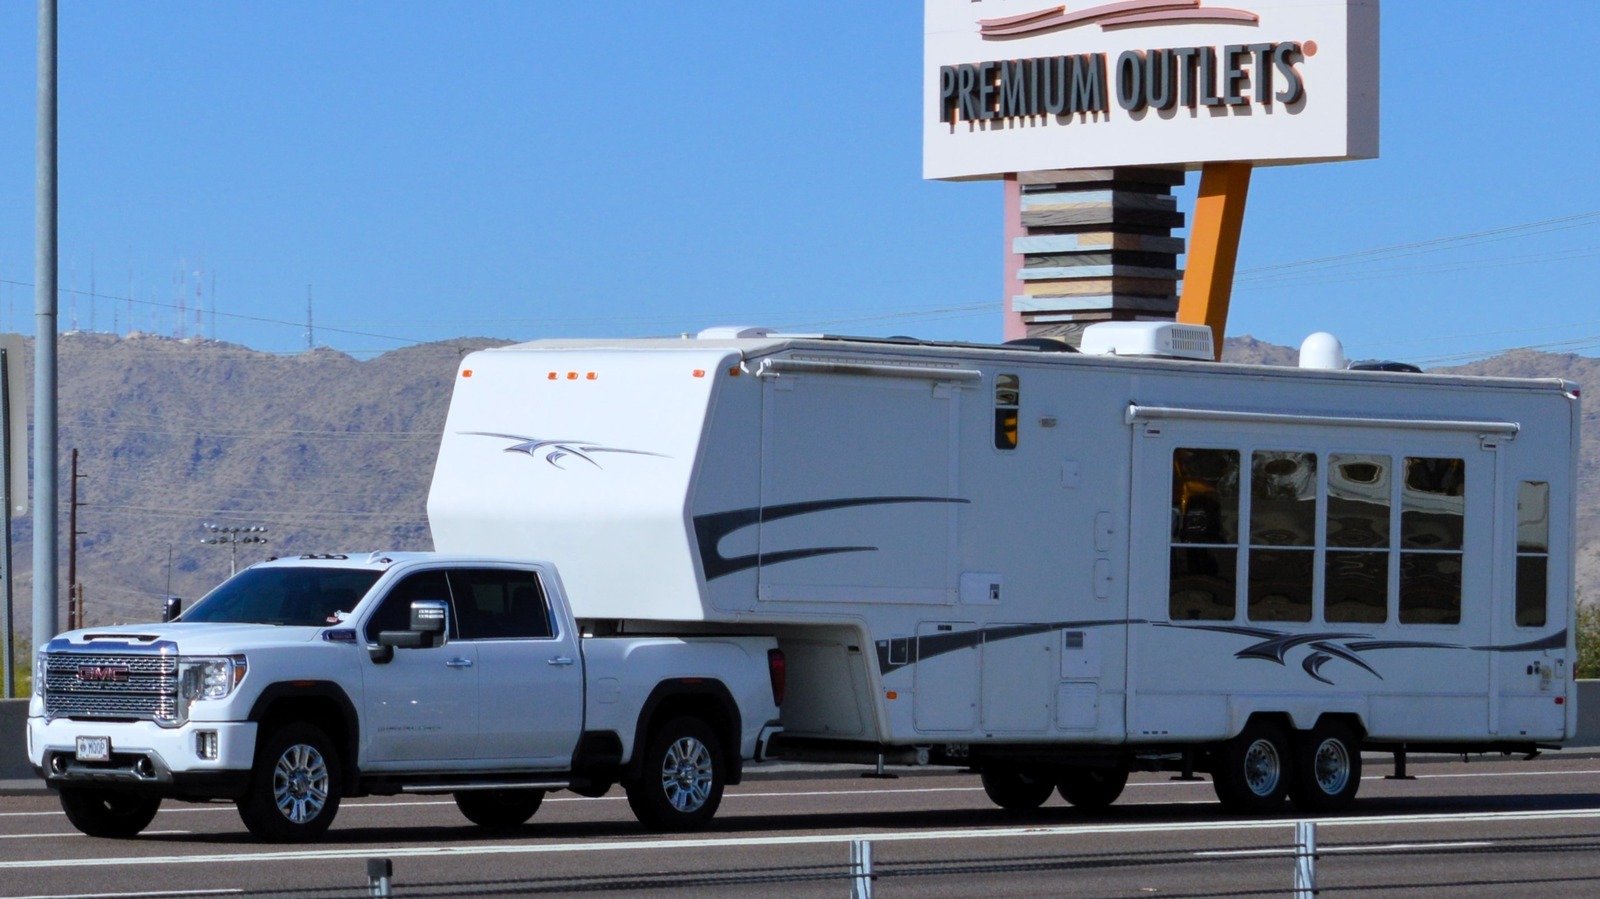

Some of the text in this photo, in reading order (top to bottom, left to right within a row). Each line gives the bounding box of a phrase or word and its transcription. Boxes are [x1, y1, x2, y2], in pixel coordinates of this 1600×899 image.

[940, 41, 1304, 124] PREMIUM OUTLETS
[78, 666, 128, 681] GMC
